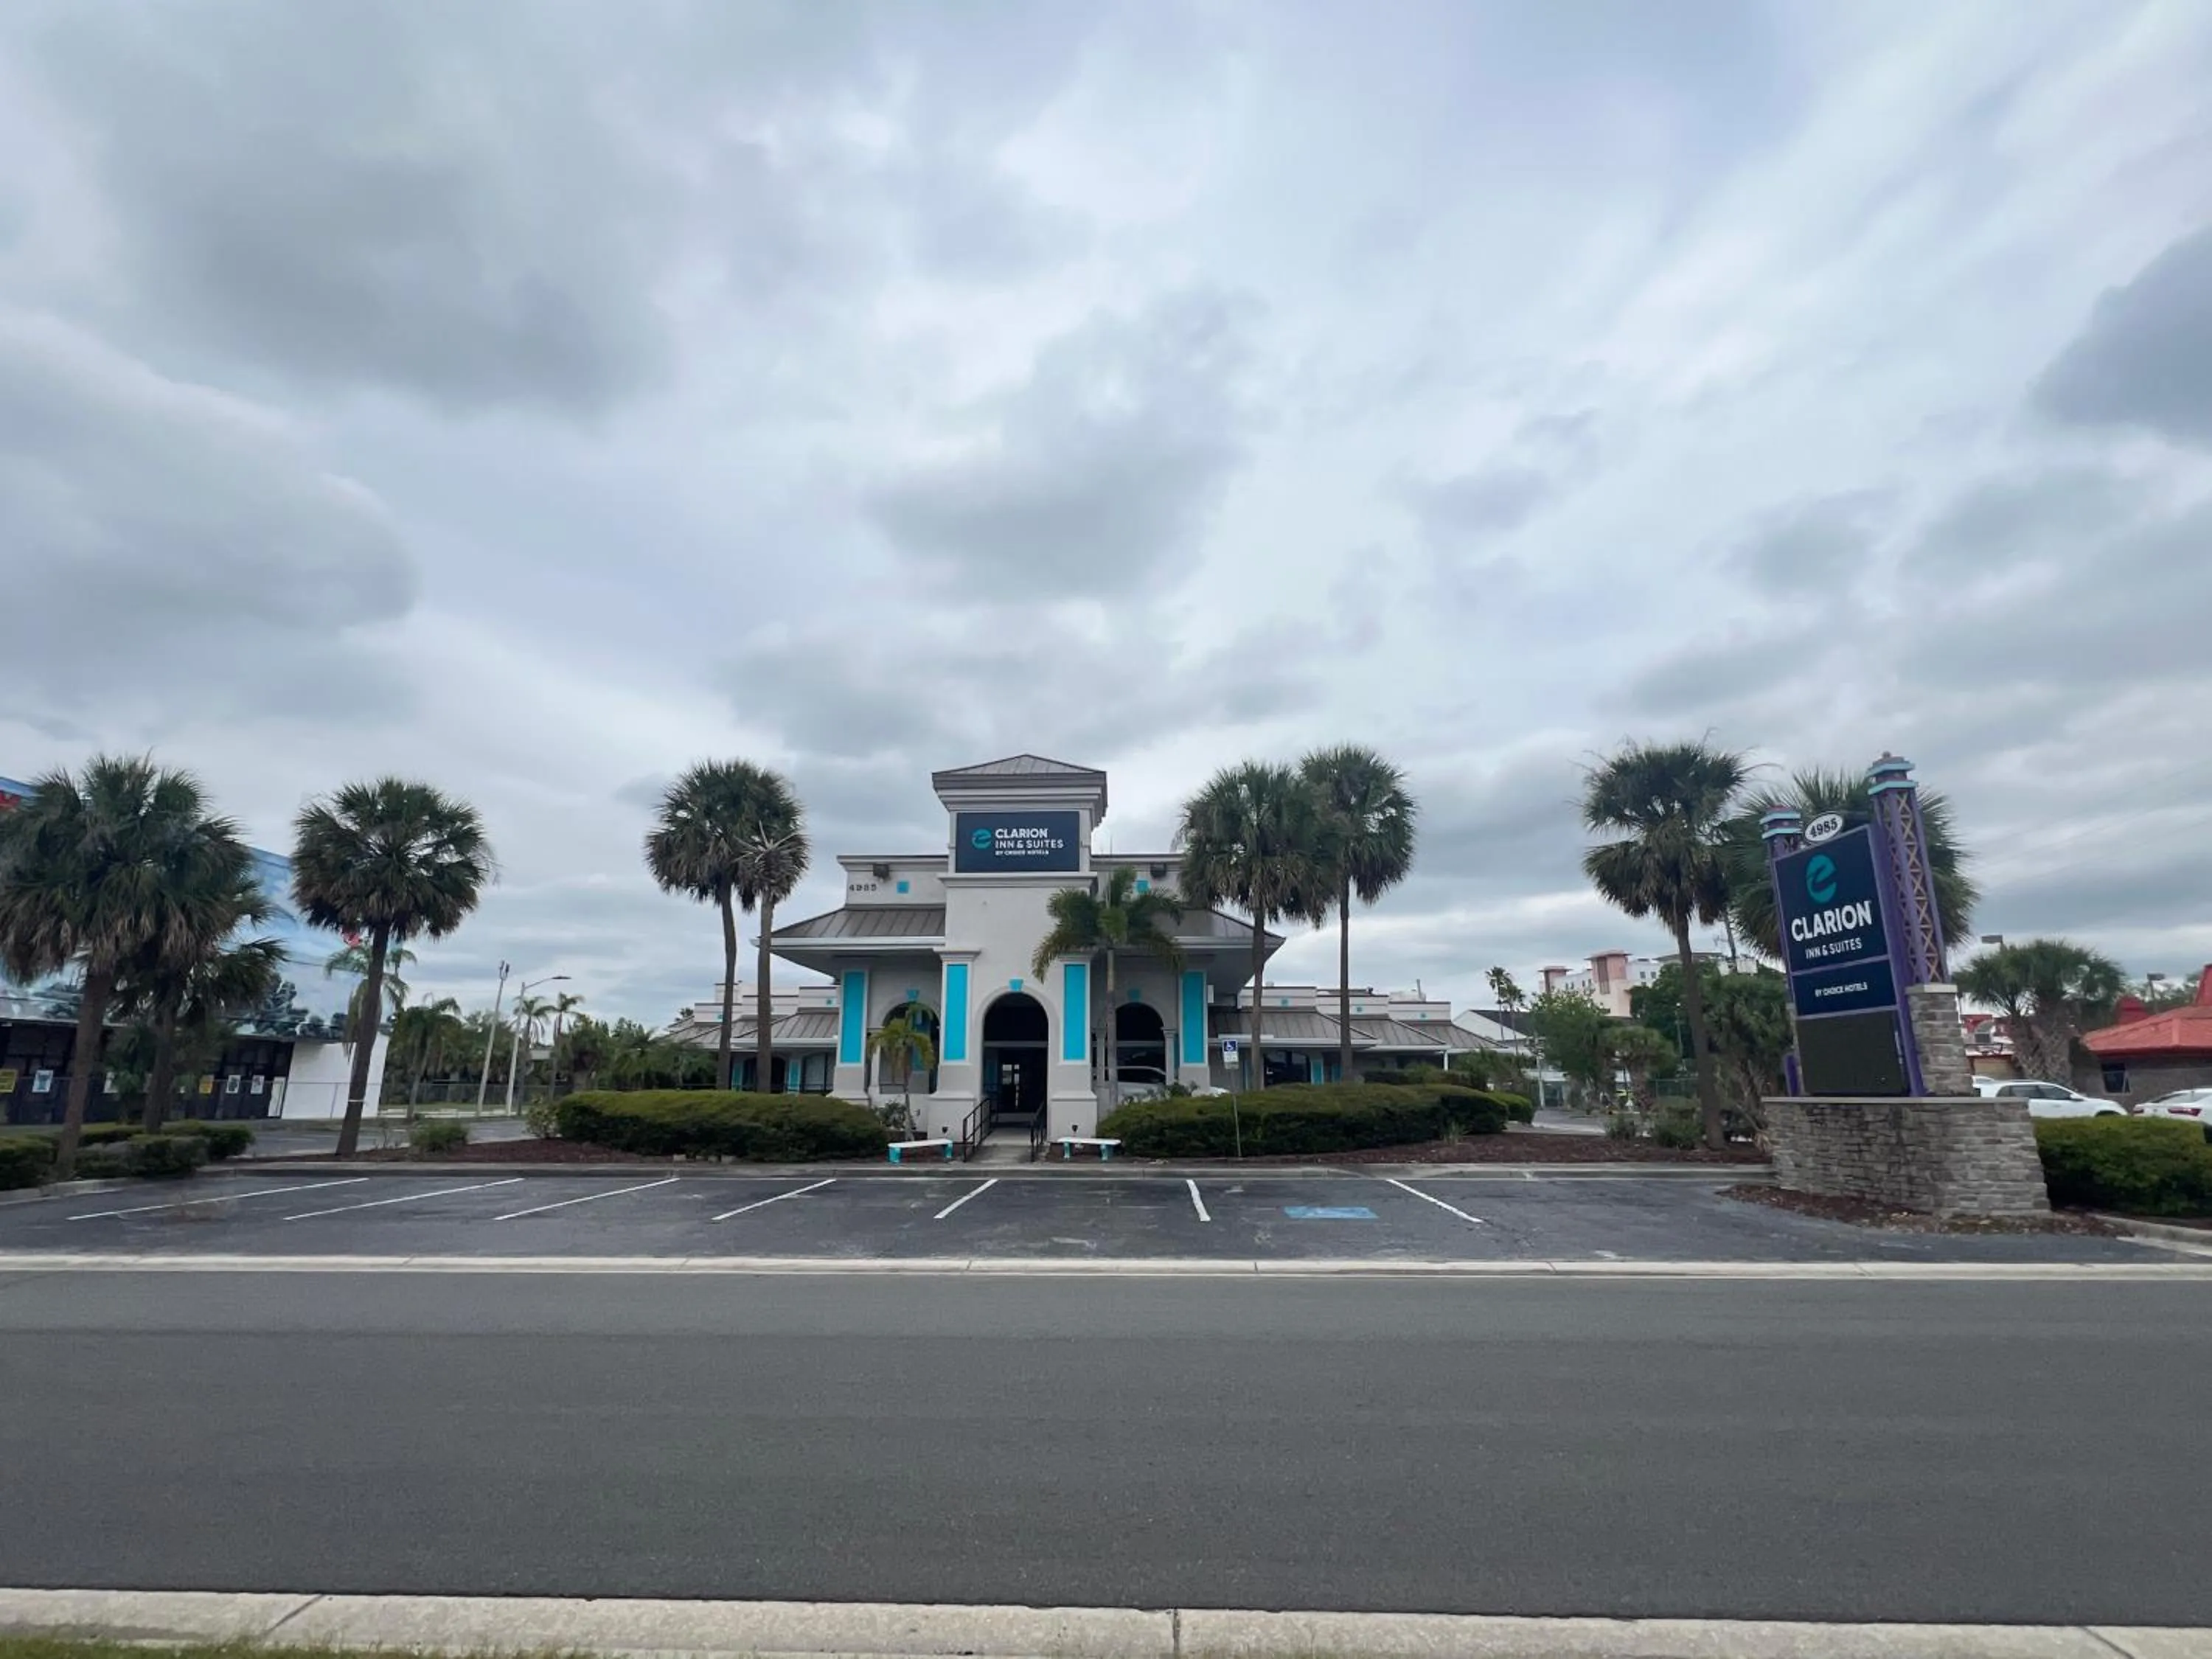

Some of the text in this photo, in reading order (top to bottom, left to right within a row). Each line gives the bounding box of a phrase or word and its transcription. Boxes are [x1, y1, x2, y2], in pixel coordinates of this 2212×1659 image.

[995, 828, 1048, 838] CLARION
[1810, 818, 1837, 838] 4985
[995, 839, 1064, 849] INN & SUITES
[1791, 900, 1872, 942] CLARION
[1805, 937, 1863, 959] INN & SUITES
[1815, 981, 1868, 998] BY CHOICE HOTELS
